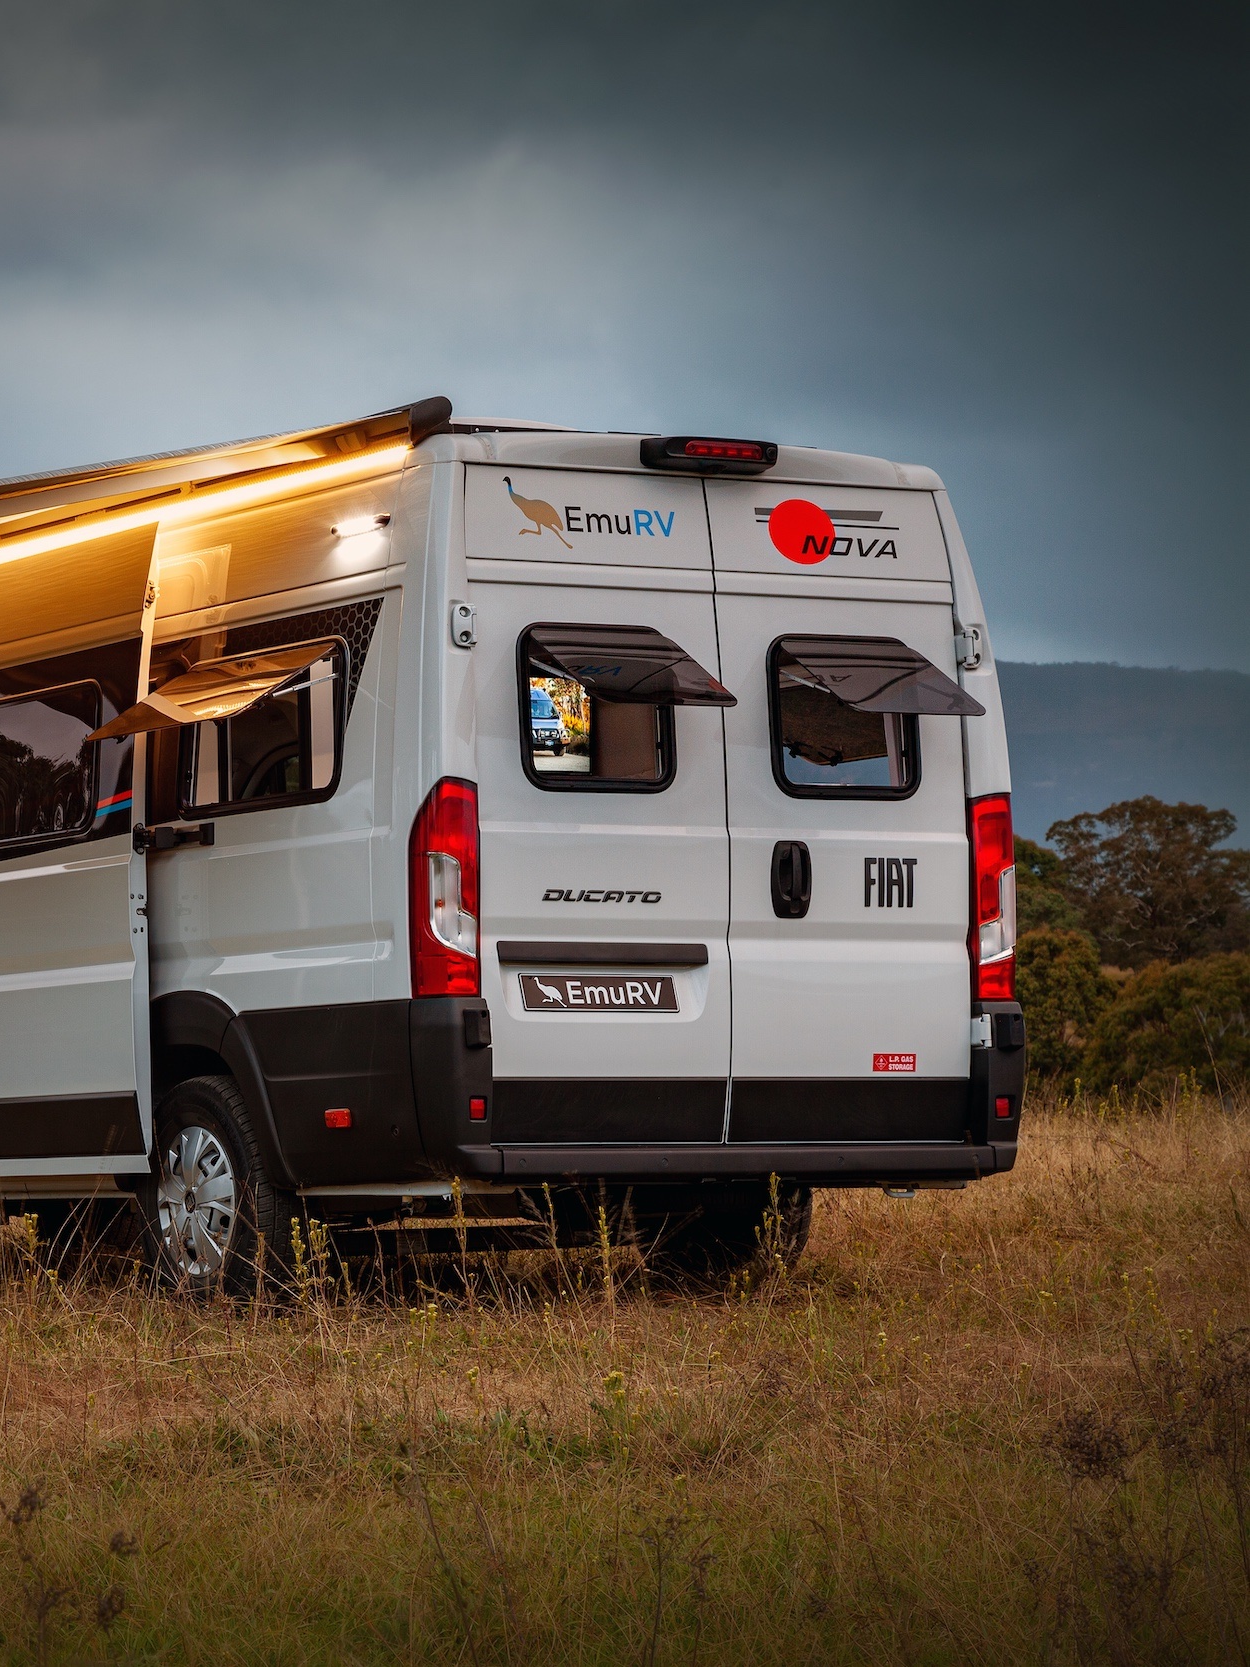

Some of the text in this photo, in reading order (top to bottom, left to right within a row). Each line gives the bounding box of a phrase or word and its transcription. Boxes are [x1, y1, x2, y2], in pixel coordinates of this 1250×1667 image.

[564, 506, 675, 538] EmuRV
[802, 535, 898, 559] NOVA
[864, 857, 918, 908] FIAT
[542, 888, 662, 903] DUCATO
[565, 981, 663, 1005] EmuRV
